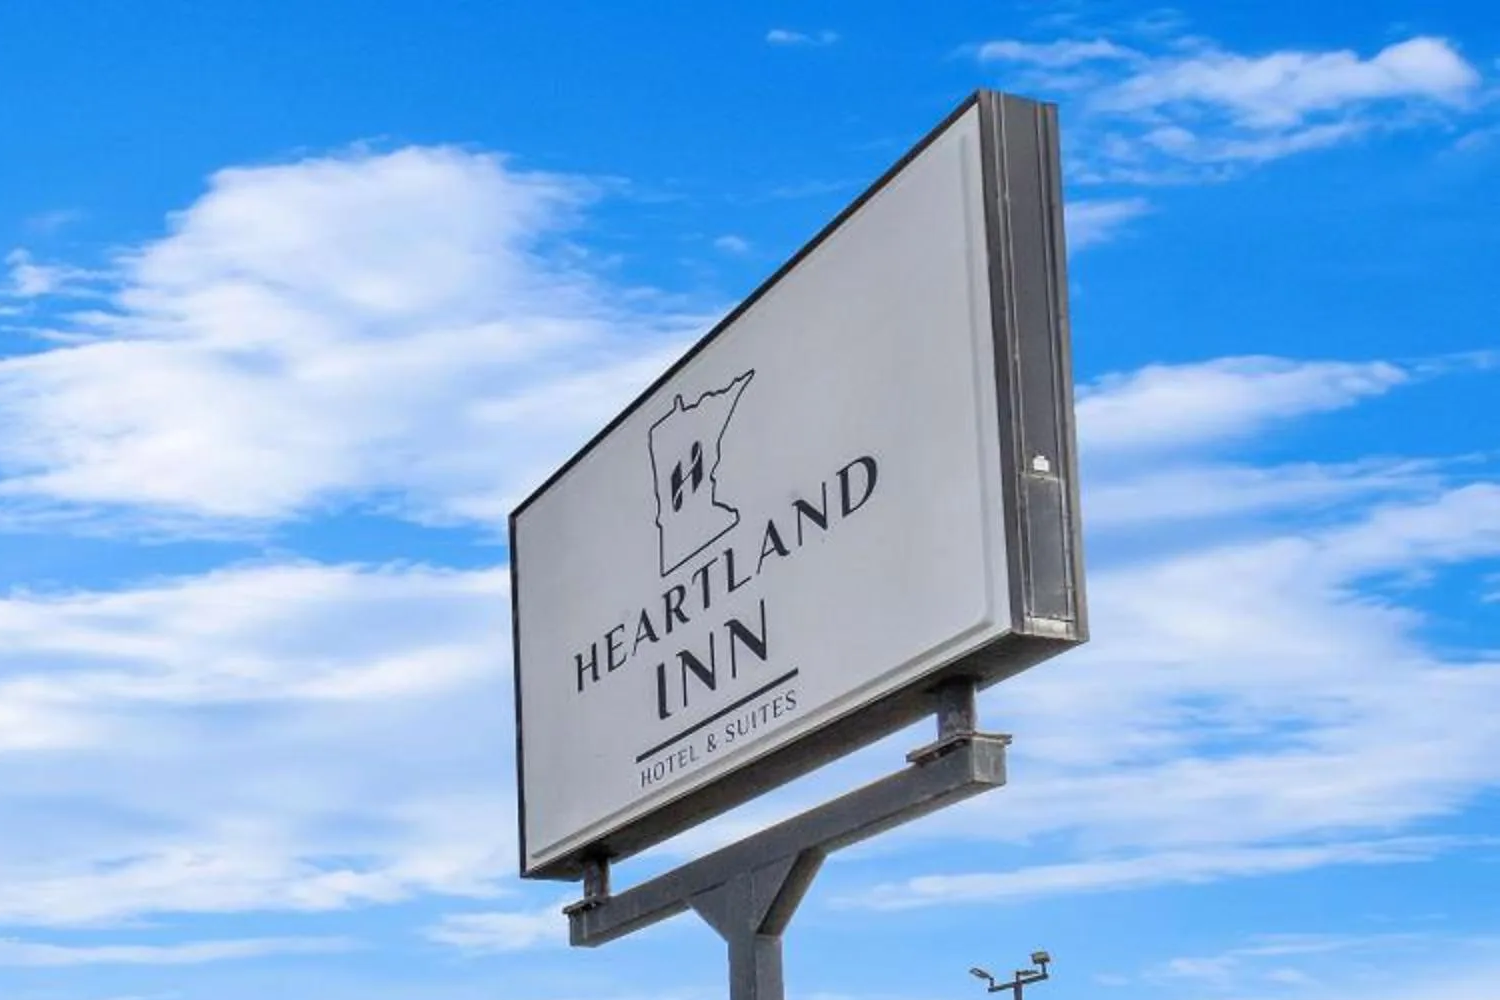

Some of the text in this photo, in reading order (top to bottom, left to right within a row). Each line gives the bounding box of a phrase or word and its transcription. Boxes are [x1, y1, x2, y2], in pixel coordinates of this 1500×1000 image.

[575, 455, 878, 693] HEARTLAND
[656, 600, 768, 720] INN
[640, 689, 797, 788] HOTEL & SUITES
